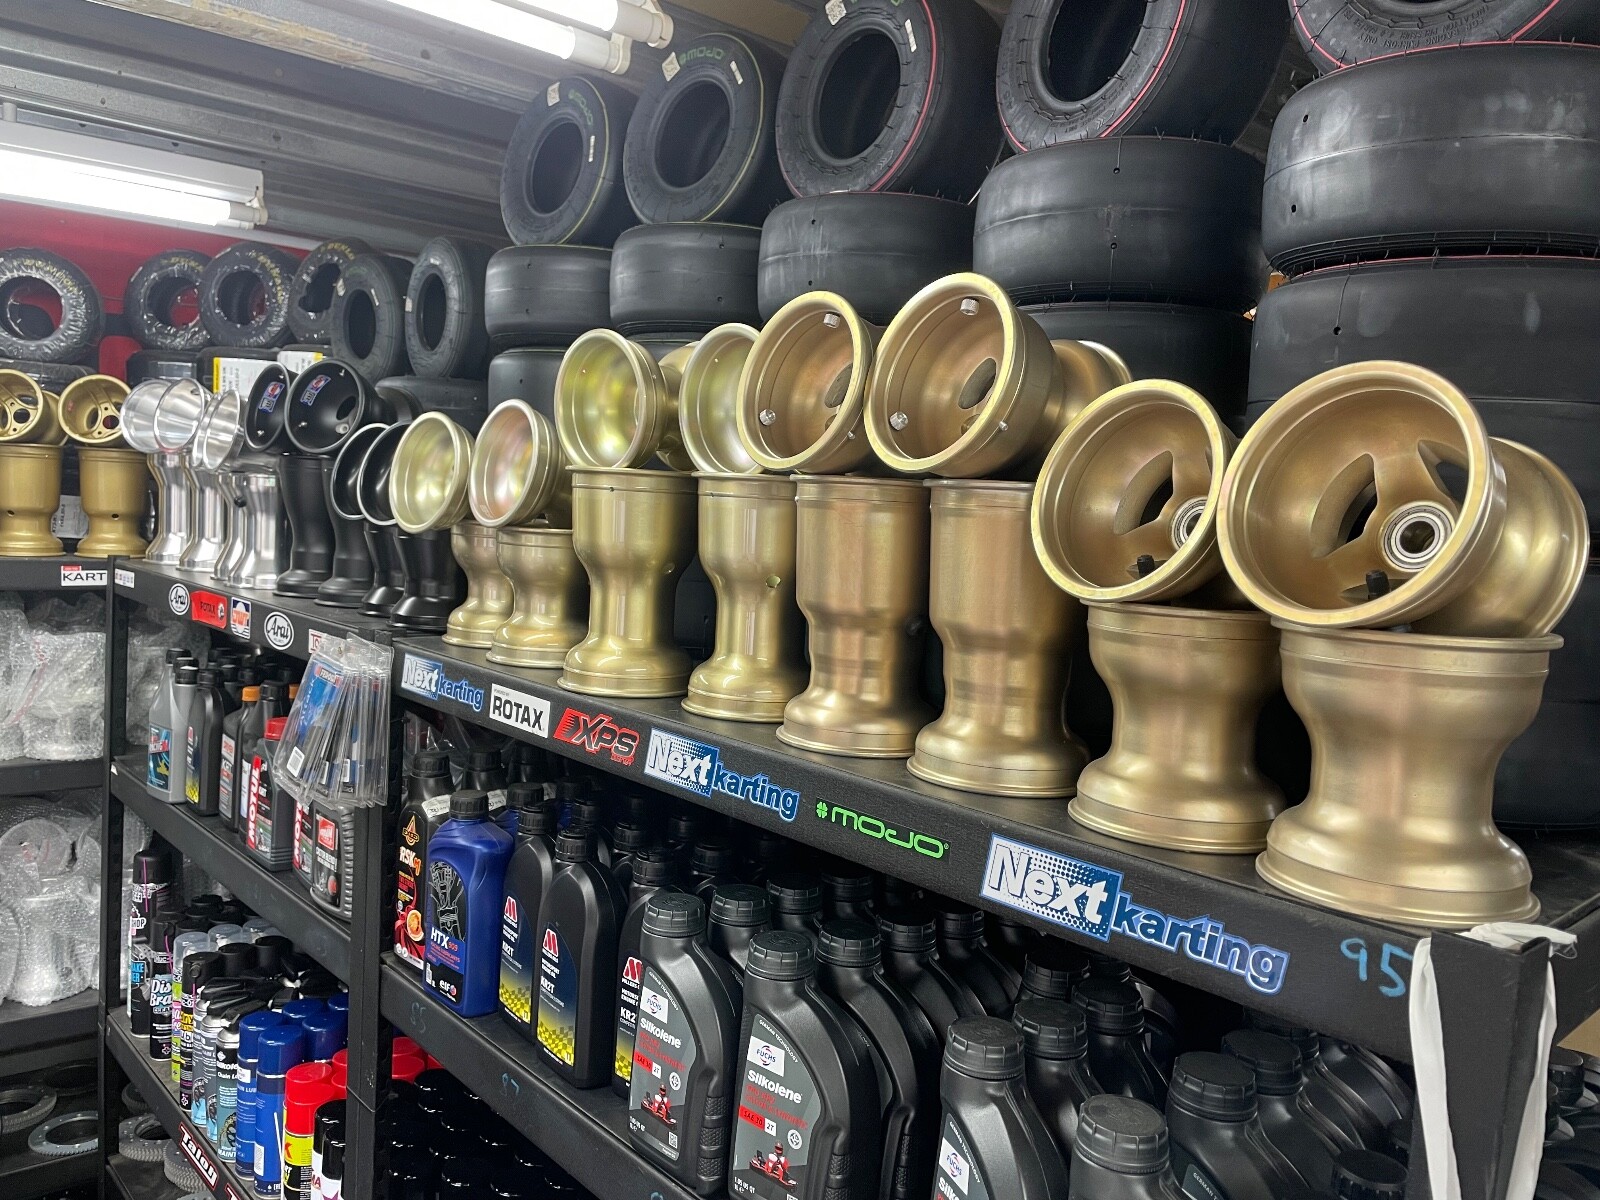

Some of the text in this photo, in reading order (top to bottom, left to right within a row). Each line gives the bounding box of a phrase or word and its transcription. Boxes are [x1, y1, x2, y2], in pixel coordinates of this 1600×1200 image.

[63, 572, 107, 582] KART
[268, 617, 290, 639] Arai
[404, 657, 483, 712] Next karting
[493, 698, 544, 731] ROTAX
[574, 713, 639, 758] XPS
[648, 733, 800, 822] Next karting
[248, 767, 260, 842] MOTUL
[987, 844, 1290, 995] Next karting
[431, 927, 449, 949] HTX
[1340, 937, 1414, 997] 95
[152, 979, 172, 994] Dis
[540, 975, 555, 993] KR2T
[149, 993, 173, 1007] Bra
[646, 998, 662, 1011] FUCHS
[620, 1006, 636, 1023] KR2
[640, 1017, 682, 1048] Silkolene
[756, 1048, 776, 1063] FUCHS
[775, 1033, 798, 1063] TECHNOLOGY
[747, 1069, 802, 1104] Silkolene
[744, 1110, 763, 1126] SAE 30
[766, 1122, 774, 1132] 2T
[180, 1124, 218, 1187] Talon
[946, 1154, 963, 1176] FUCHS
[961, 1143, 981, 1183] TECHNOLOGY
[1193, 1172, 1214, 1197] GERMAN
